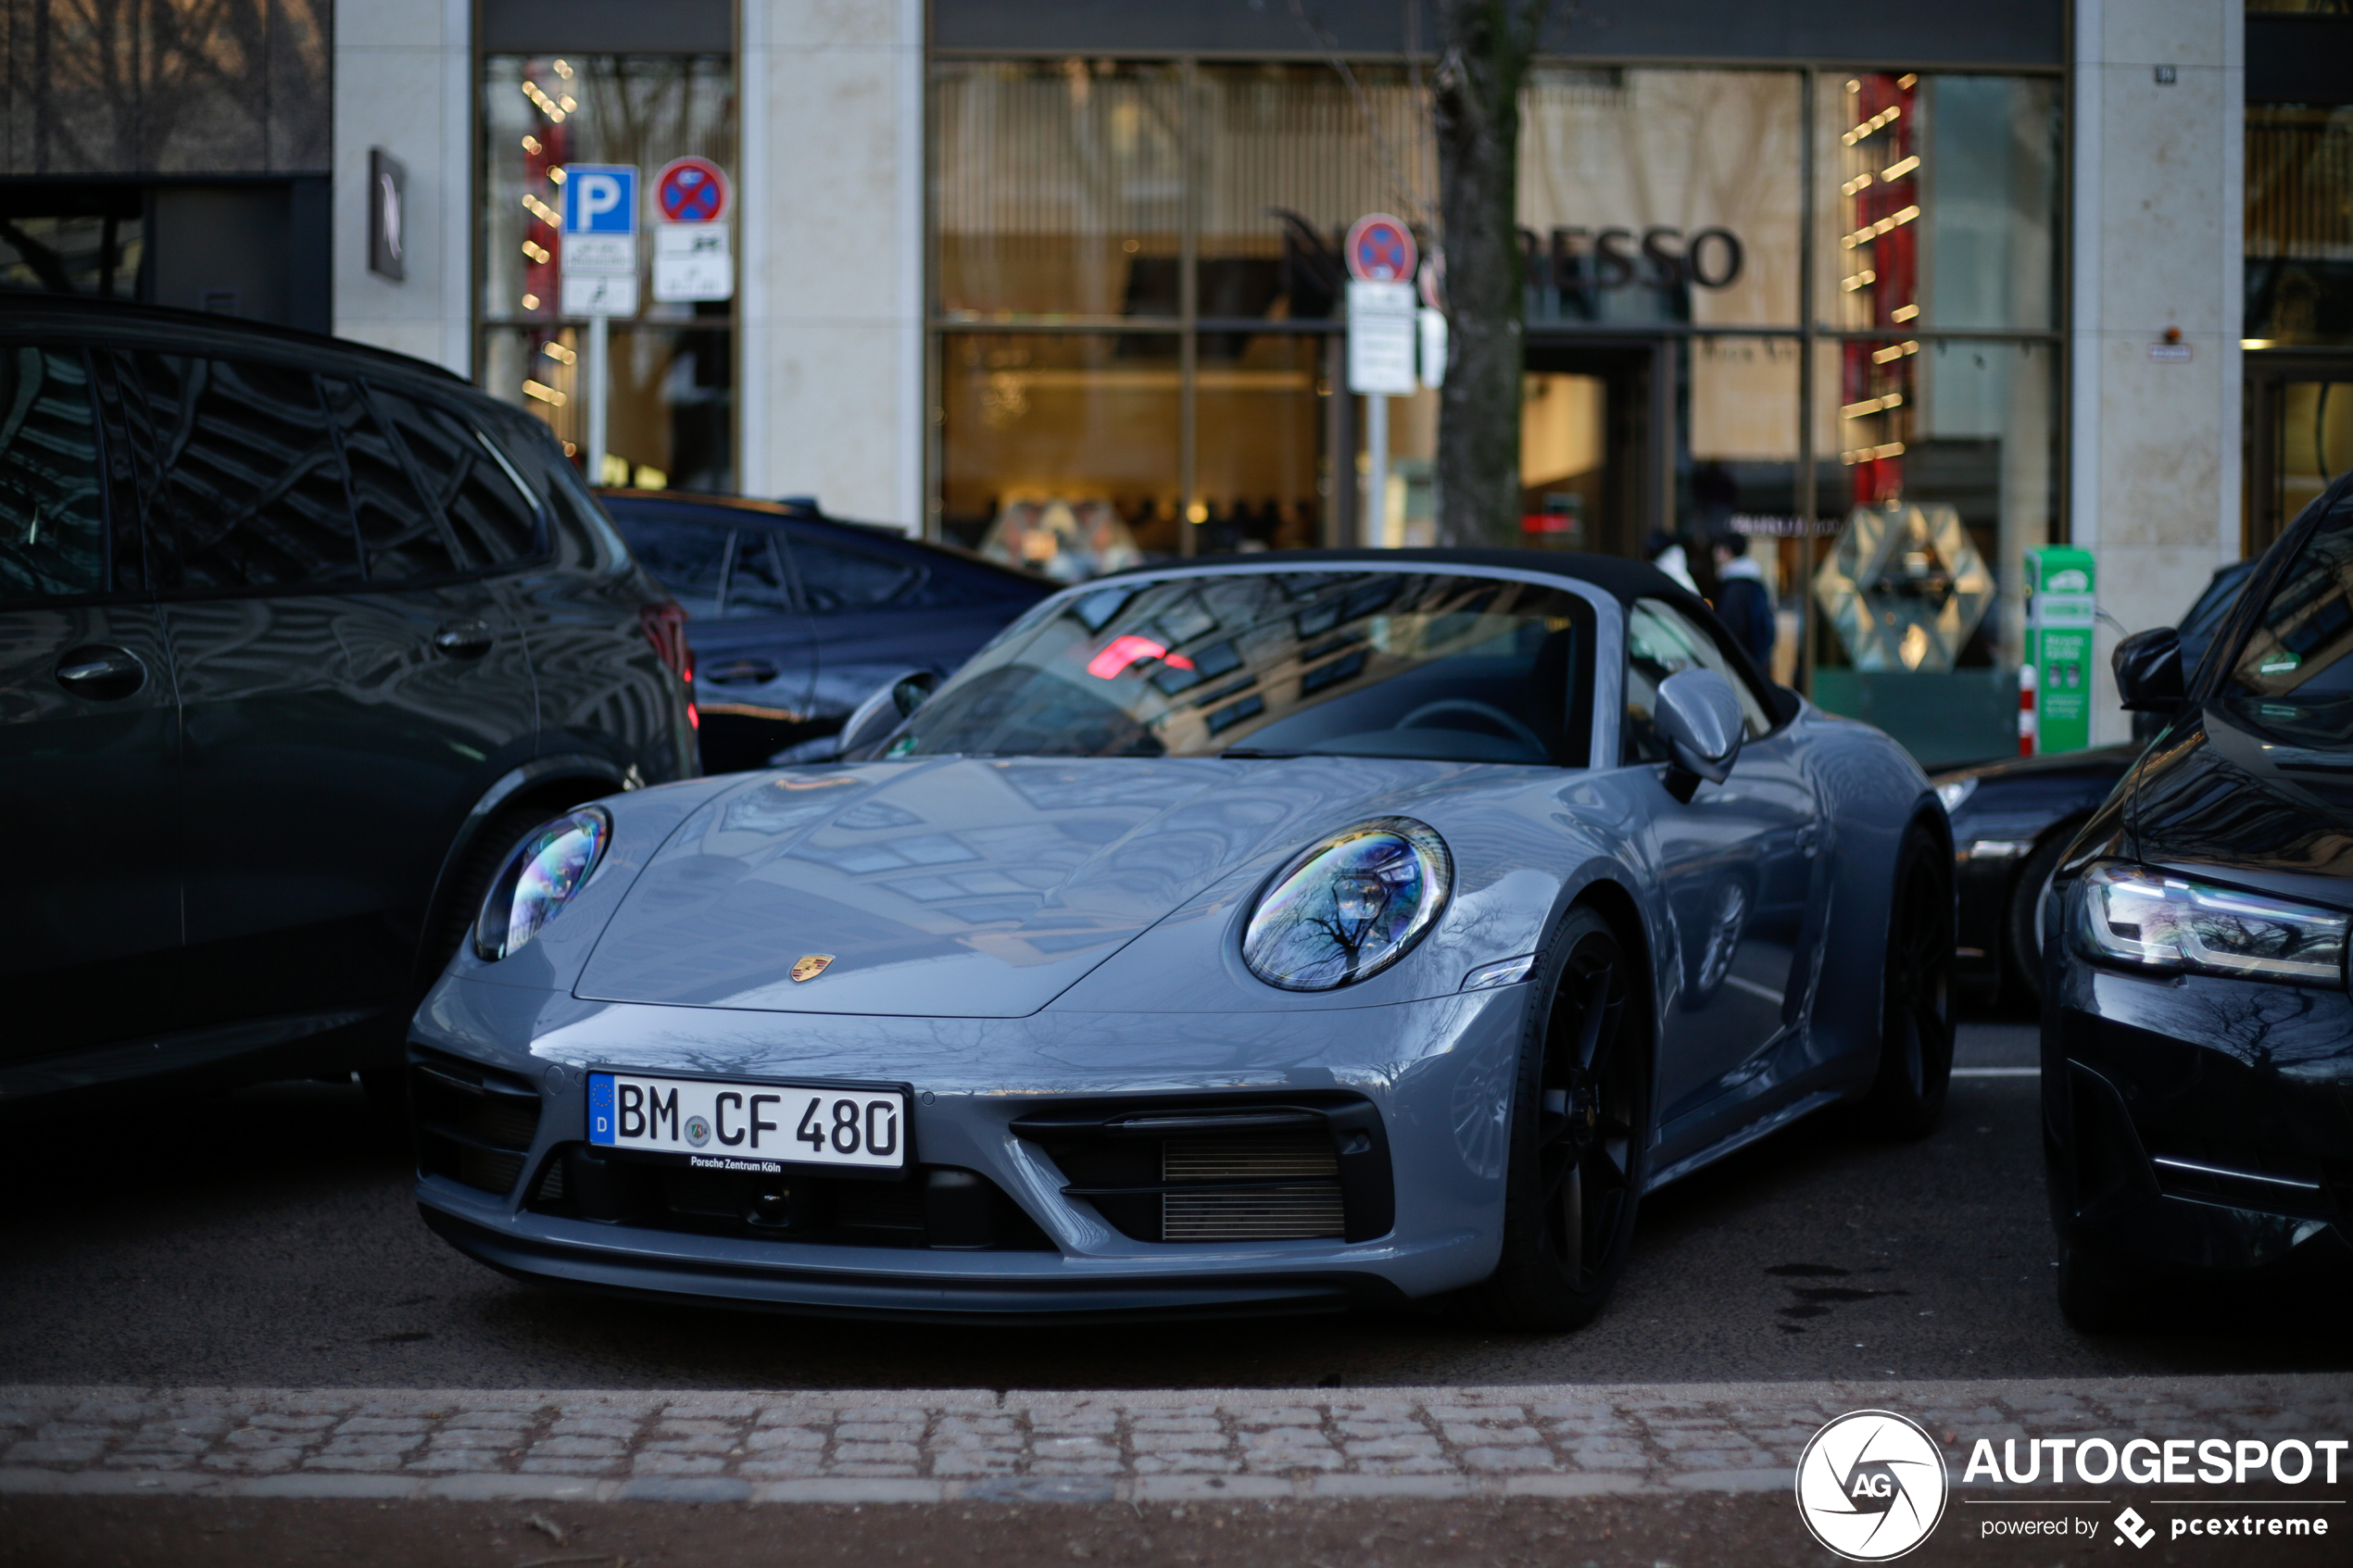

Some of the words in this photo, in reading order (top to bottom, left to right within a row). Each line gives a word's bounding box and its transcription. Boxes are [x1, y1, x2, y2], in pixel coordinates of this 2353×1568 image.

[577, 174, 621, 232] P
[597, 1116, 608, 1133] D
[618, 1083, 679, 1142] BM
[715, 1090, 782, 1149] CF
[796, 1097, 897, 1157] 480
[691, 1156, 724, 1169] Porsche
[724, 1159, 761, 1172] Zentrum
[761, 1161, 781, 1173] Köln
